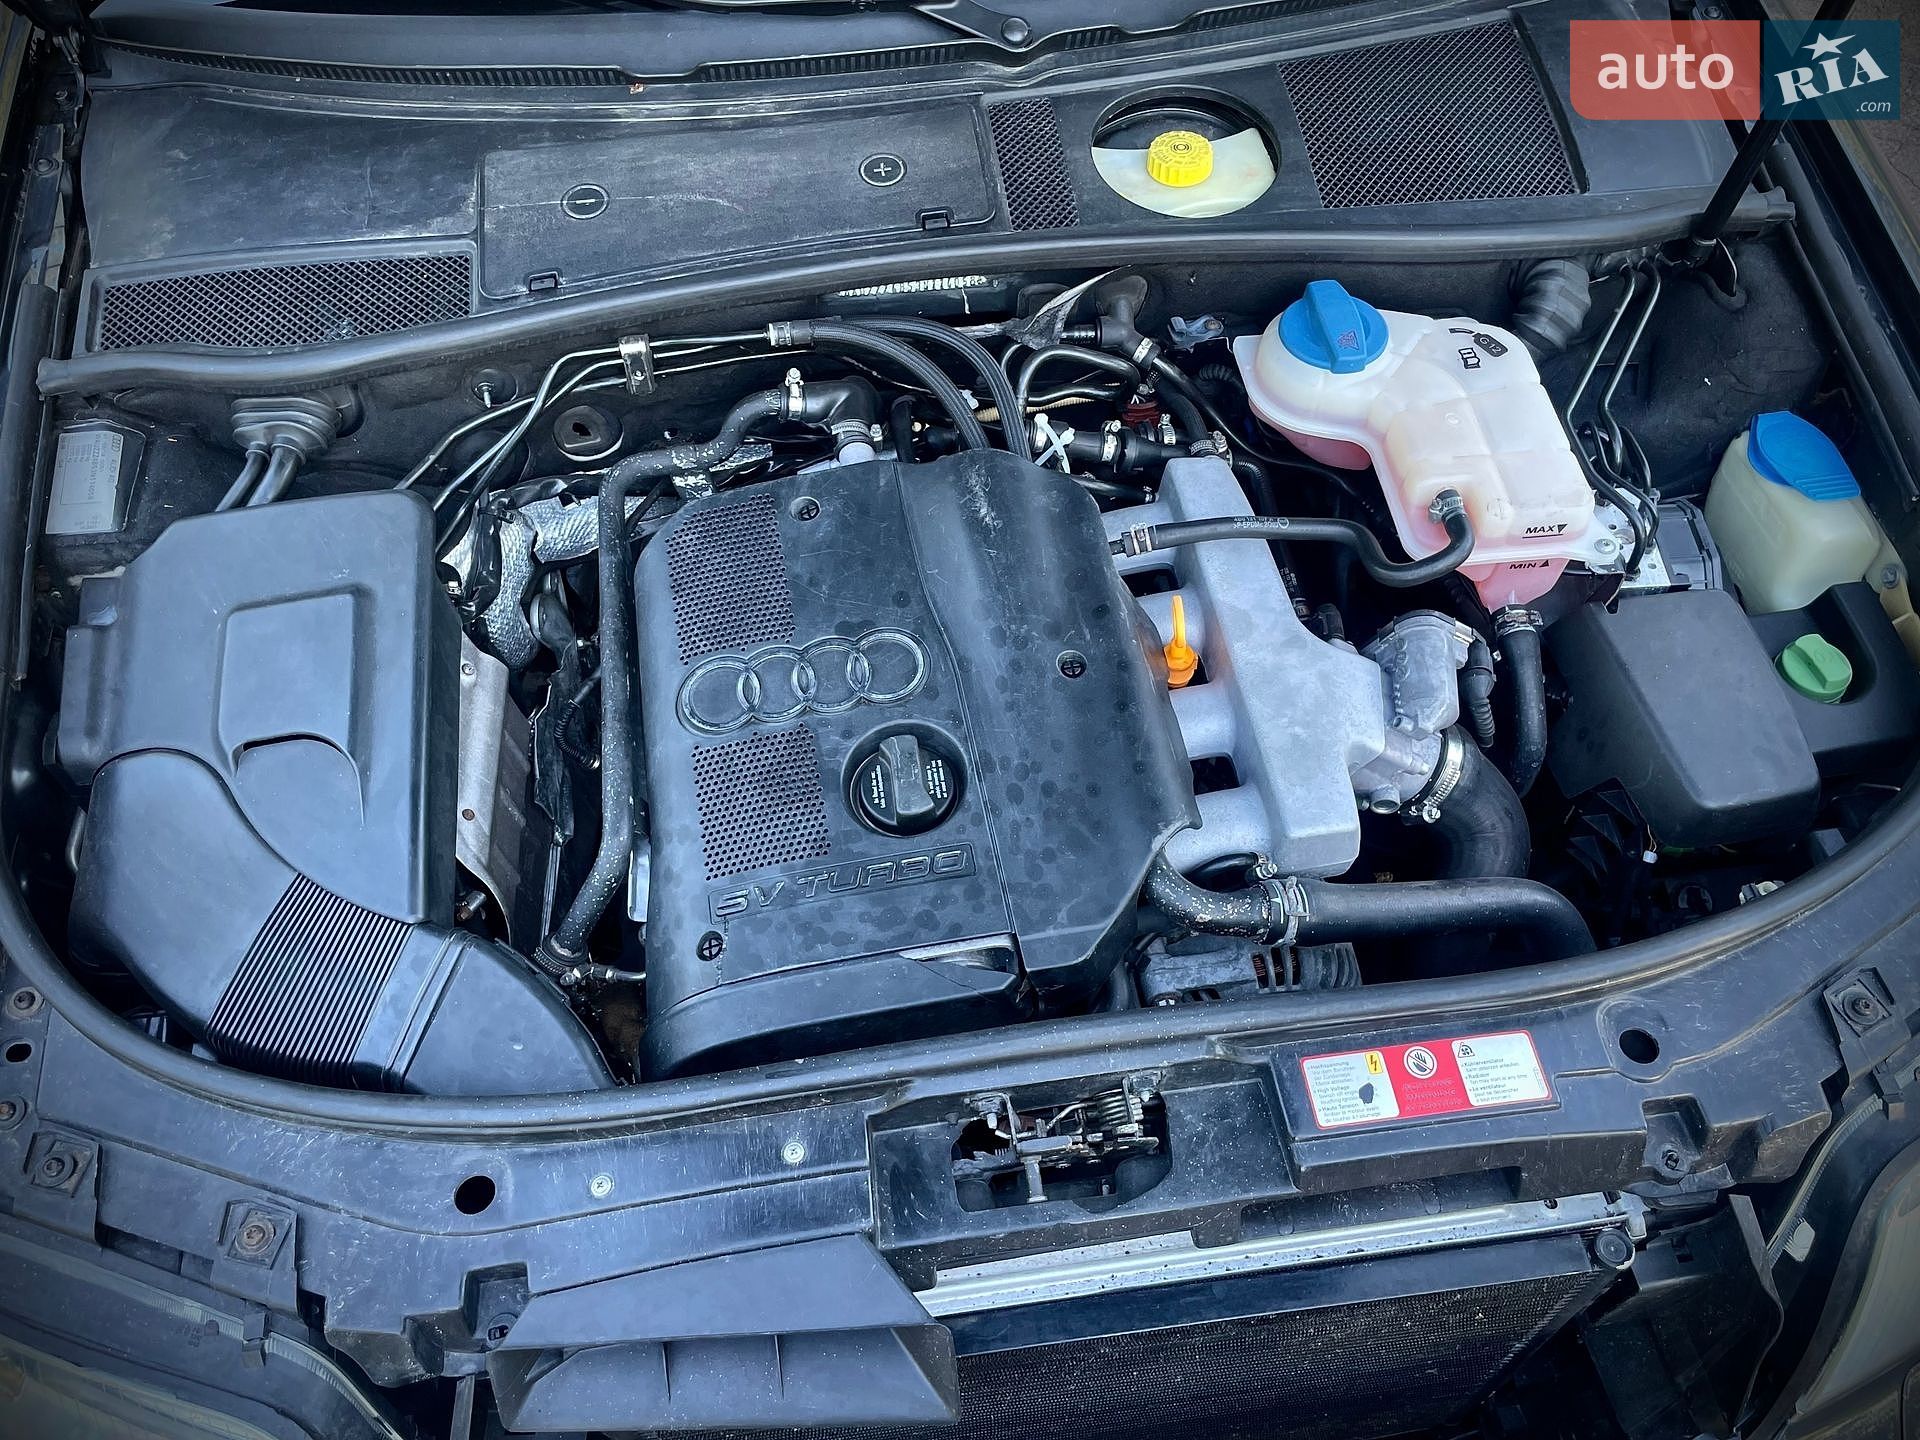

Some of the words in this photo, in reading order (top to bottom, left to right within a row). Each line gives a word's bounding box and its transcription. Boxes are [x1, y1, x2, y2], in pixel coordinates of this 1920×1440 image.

[1488, 344, 1502, 353] 12
[1525, 524, 1556, 534] MAX
[797, 850, 967, 898] TURBO
